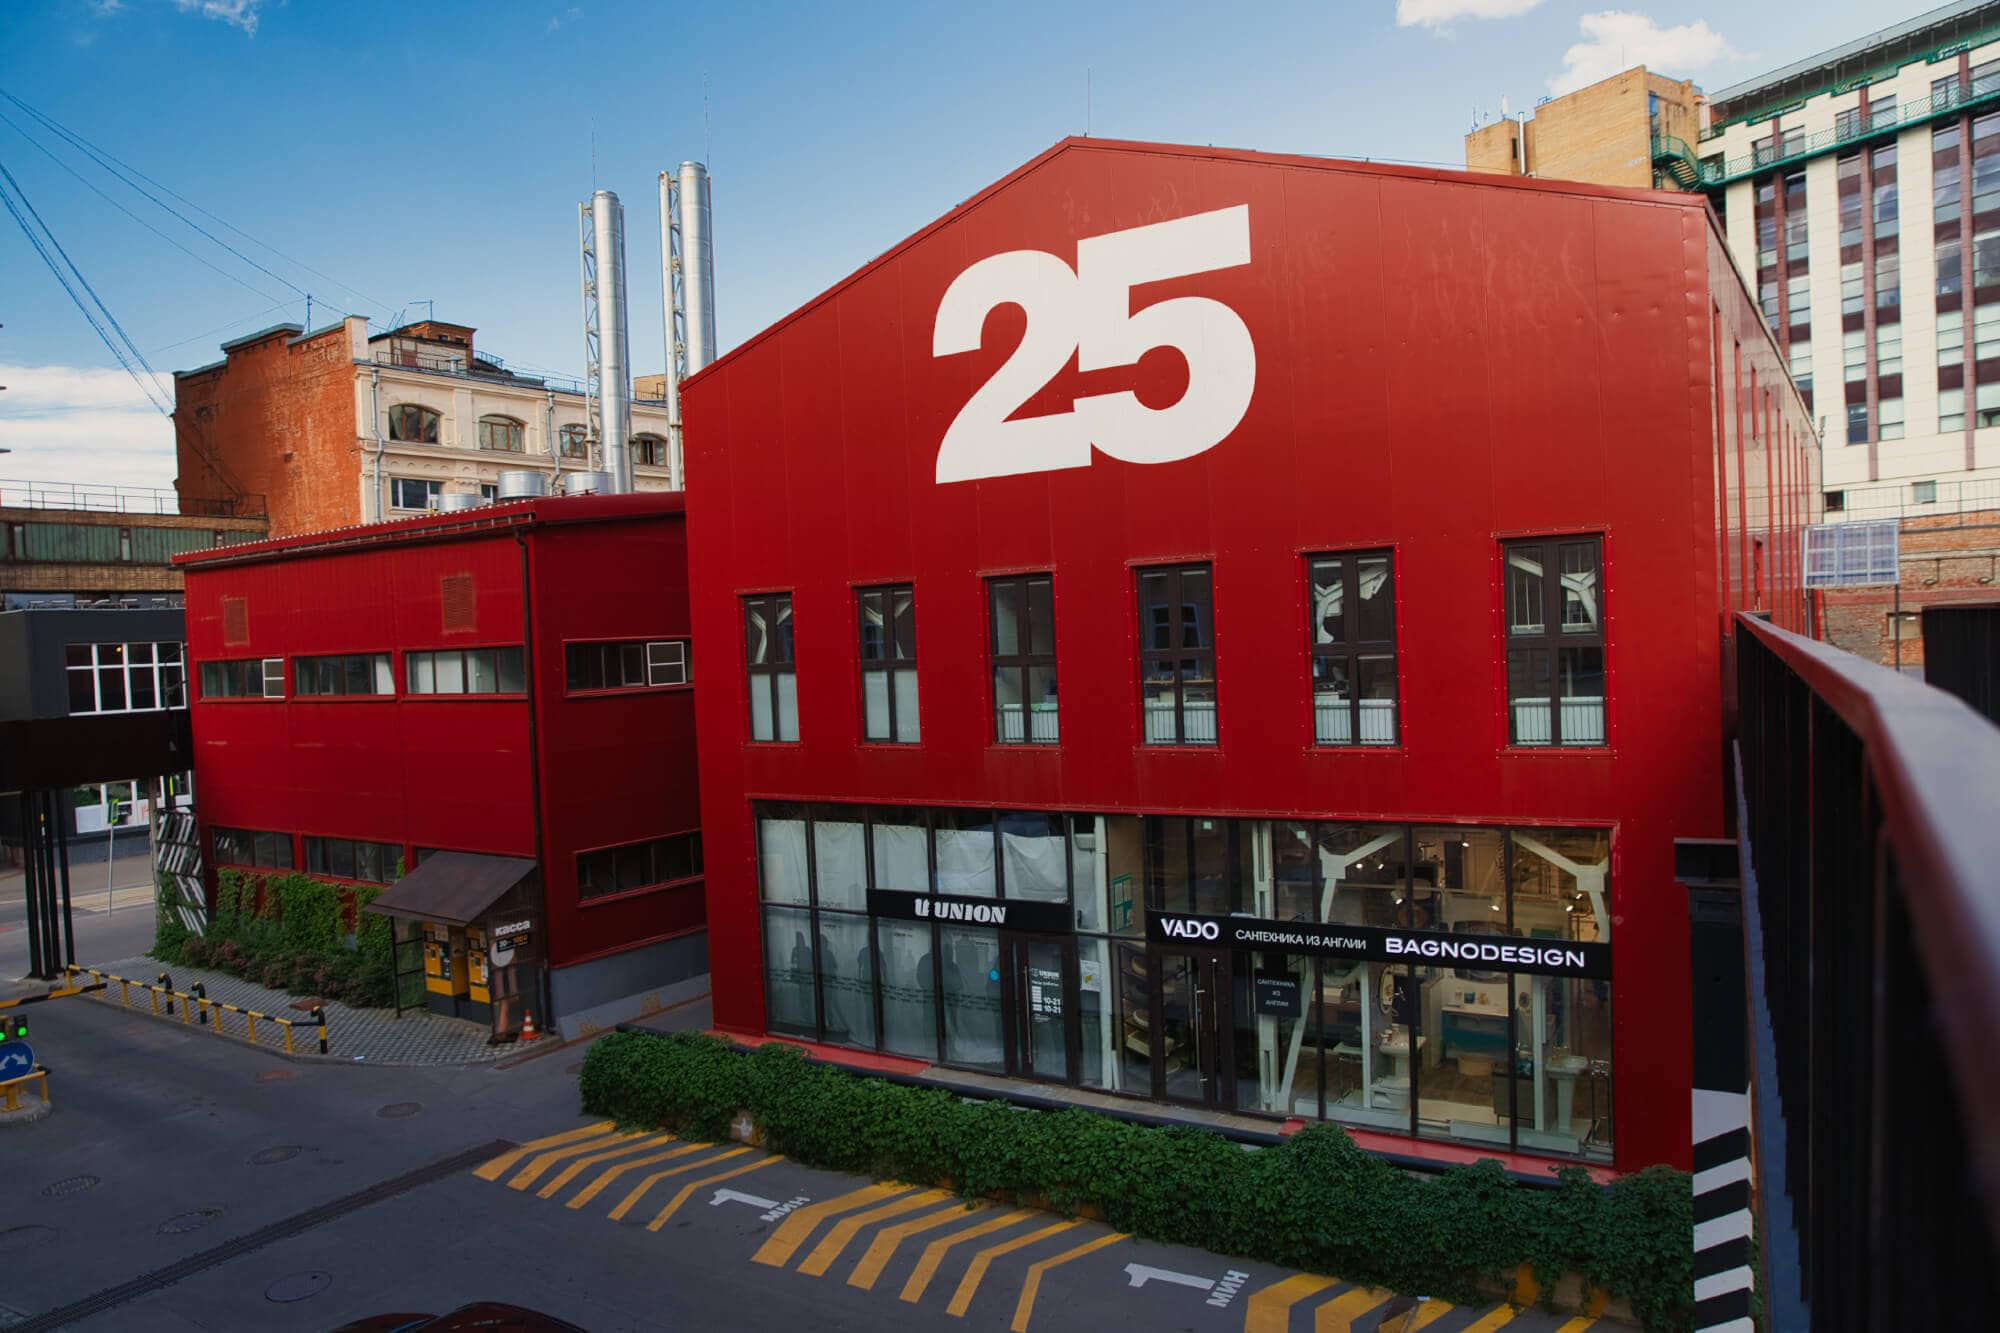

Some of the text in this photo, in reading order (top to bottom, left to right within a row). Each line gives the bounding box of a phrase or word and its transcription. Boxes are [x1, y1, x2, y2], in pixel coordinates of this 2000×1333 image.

[933, 203, 1256, 484] 25
[934, 901, 1006, 924] UNION
[1160, 918, 1219, 940] VADO
[1235, 929, 1367, 950] САНТЕХНИКА ИЗ АНГЛИИ
[1385, 937, 1585, 968] BAGNODESIGN
[709, 1188, 780, 1209] 1
[1123, 1262, 1216, 1291] 1
